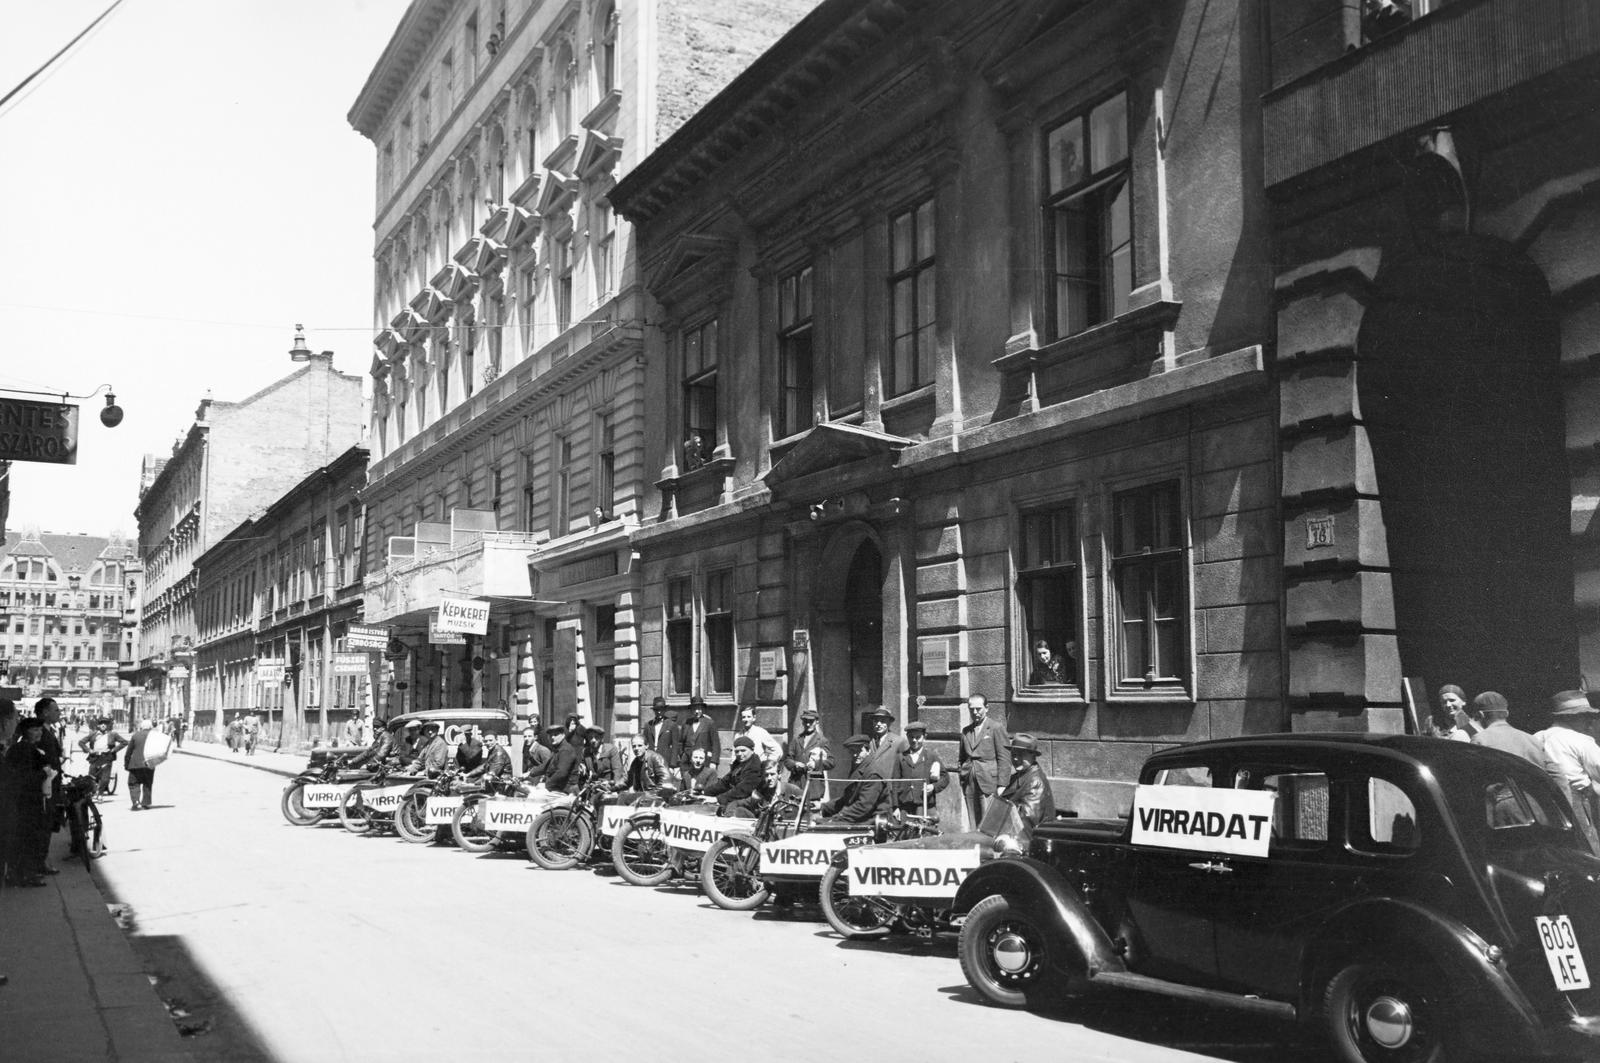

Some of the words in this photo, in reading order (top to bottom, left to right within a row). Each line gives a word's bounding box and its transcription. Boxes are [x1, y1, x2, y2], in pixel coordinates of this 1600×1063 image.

[1138, 807, 1268, 841] VIRRADAT
[1540, 921, 1575, 951] 803
[1557, 954, 1582, 985] AE
